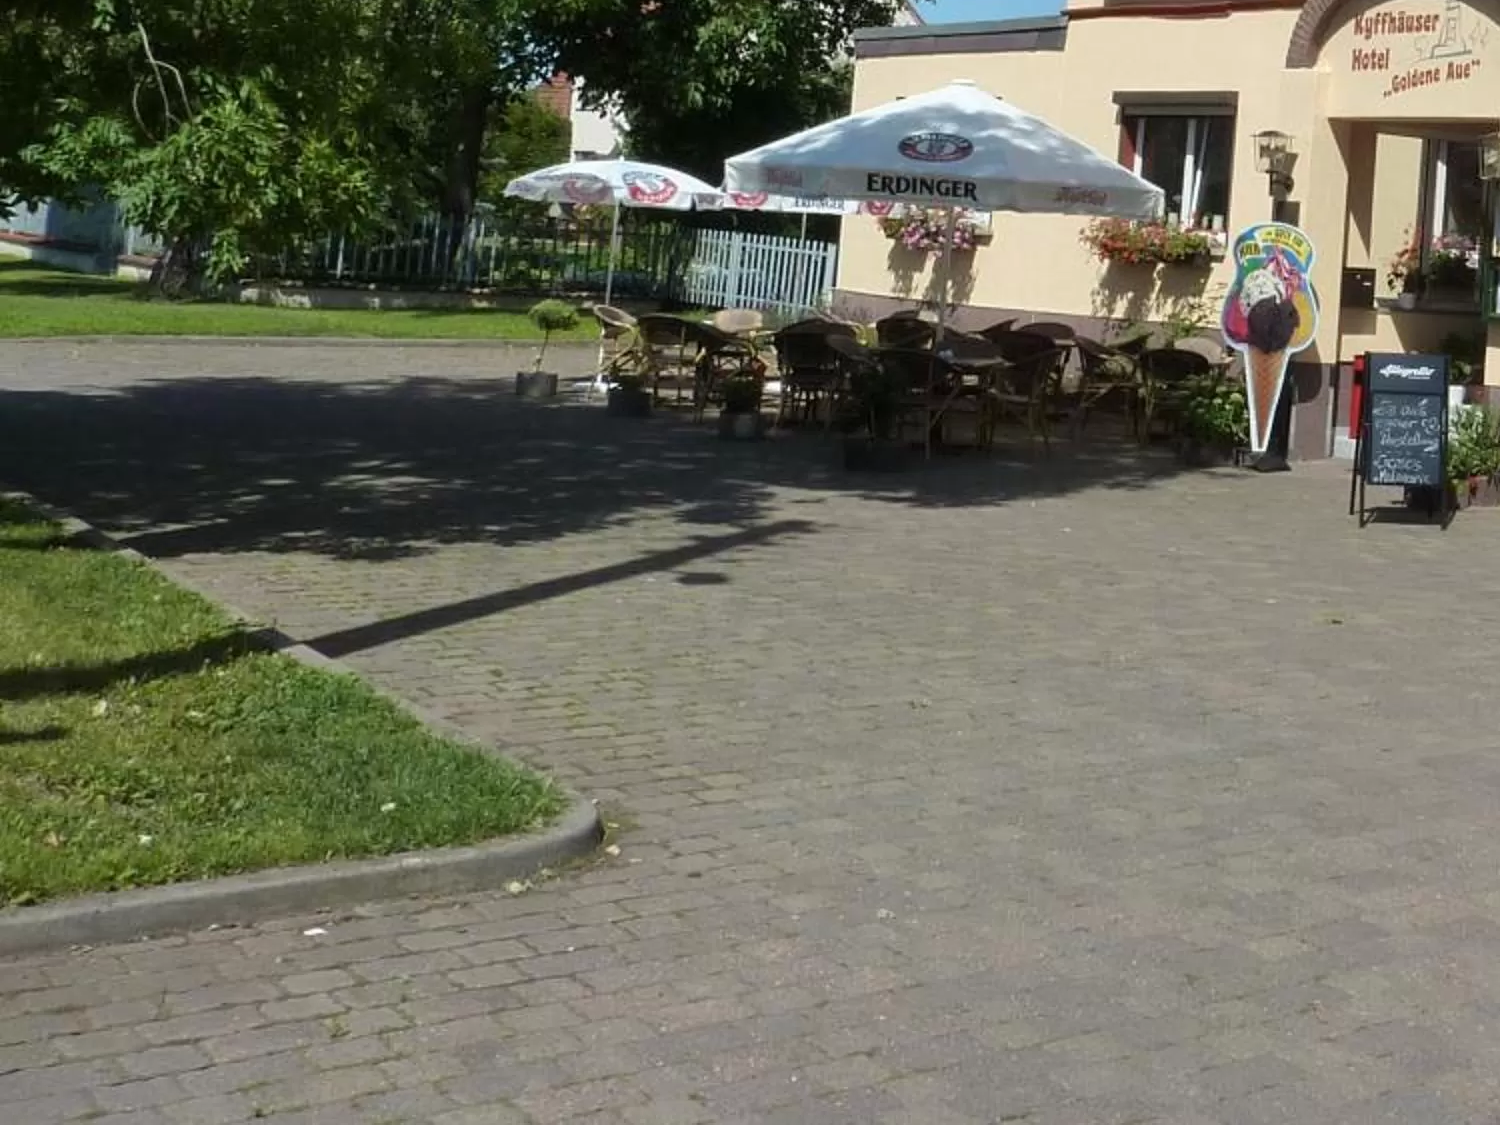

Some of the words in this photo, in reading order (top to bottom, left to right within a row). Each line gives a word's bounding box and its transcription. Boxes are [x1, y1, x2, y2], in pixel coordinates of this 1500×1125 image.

[1353, 11, 1440, 40] Kyffhäuser
[1351, 48, 1390, 72] Hotel
[866, 172, 978, 202] ERDINGER
